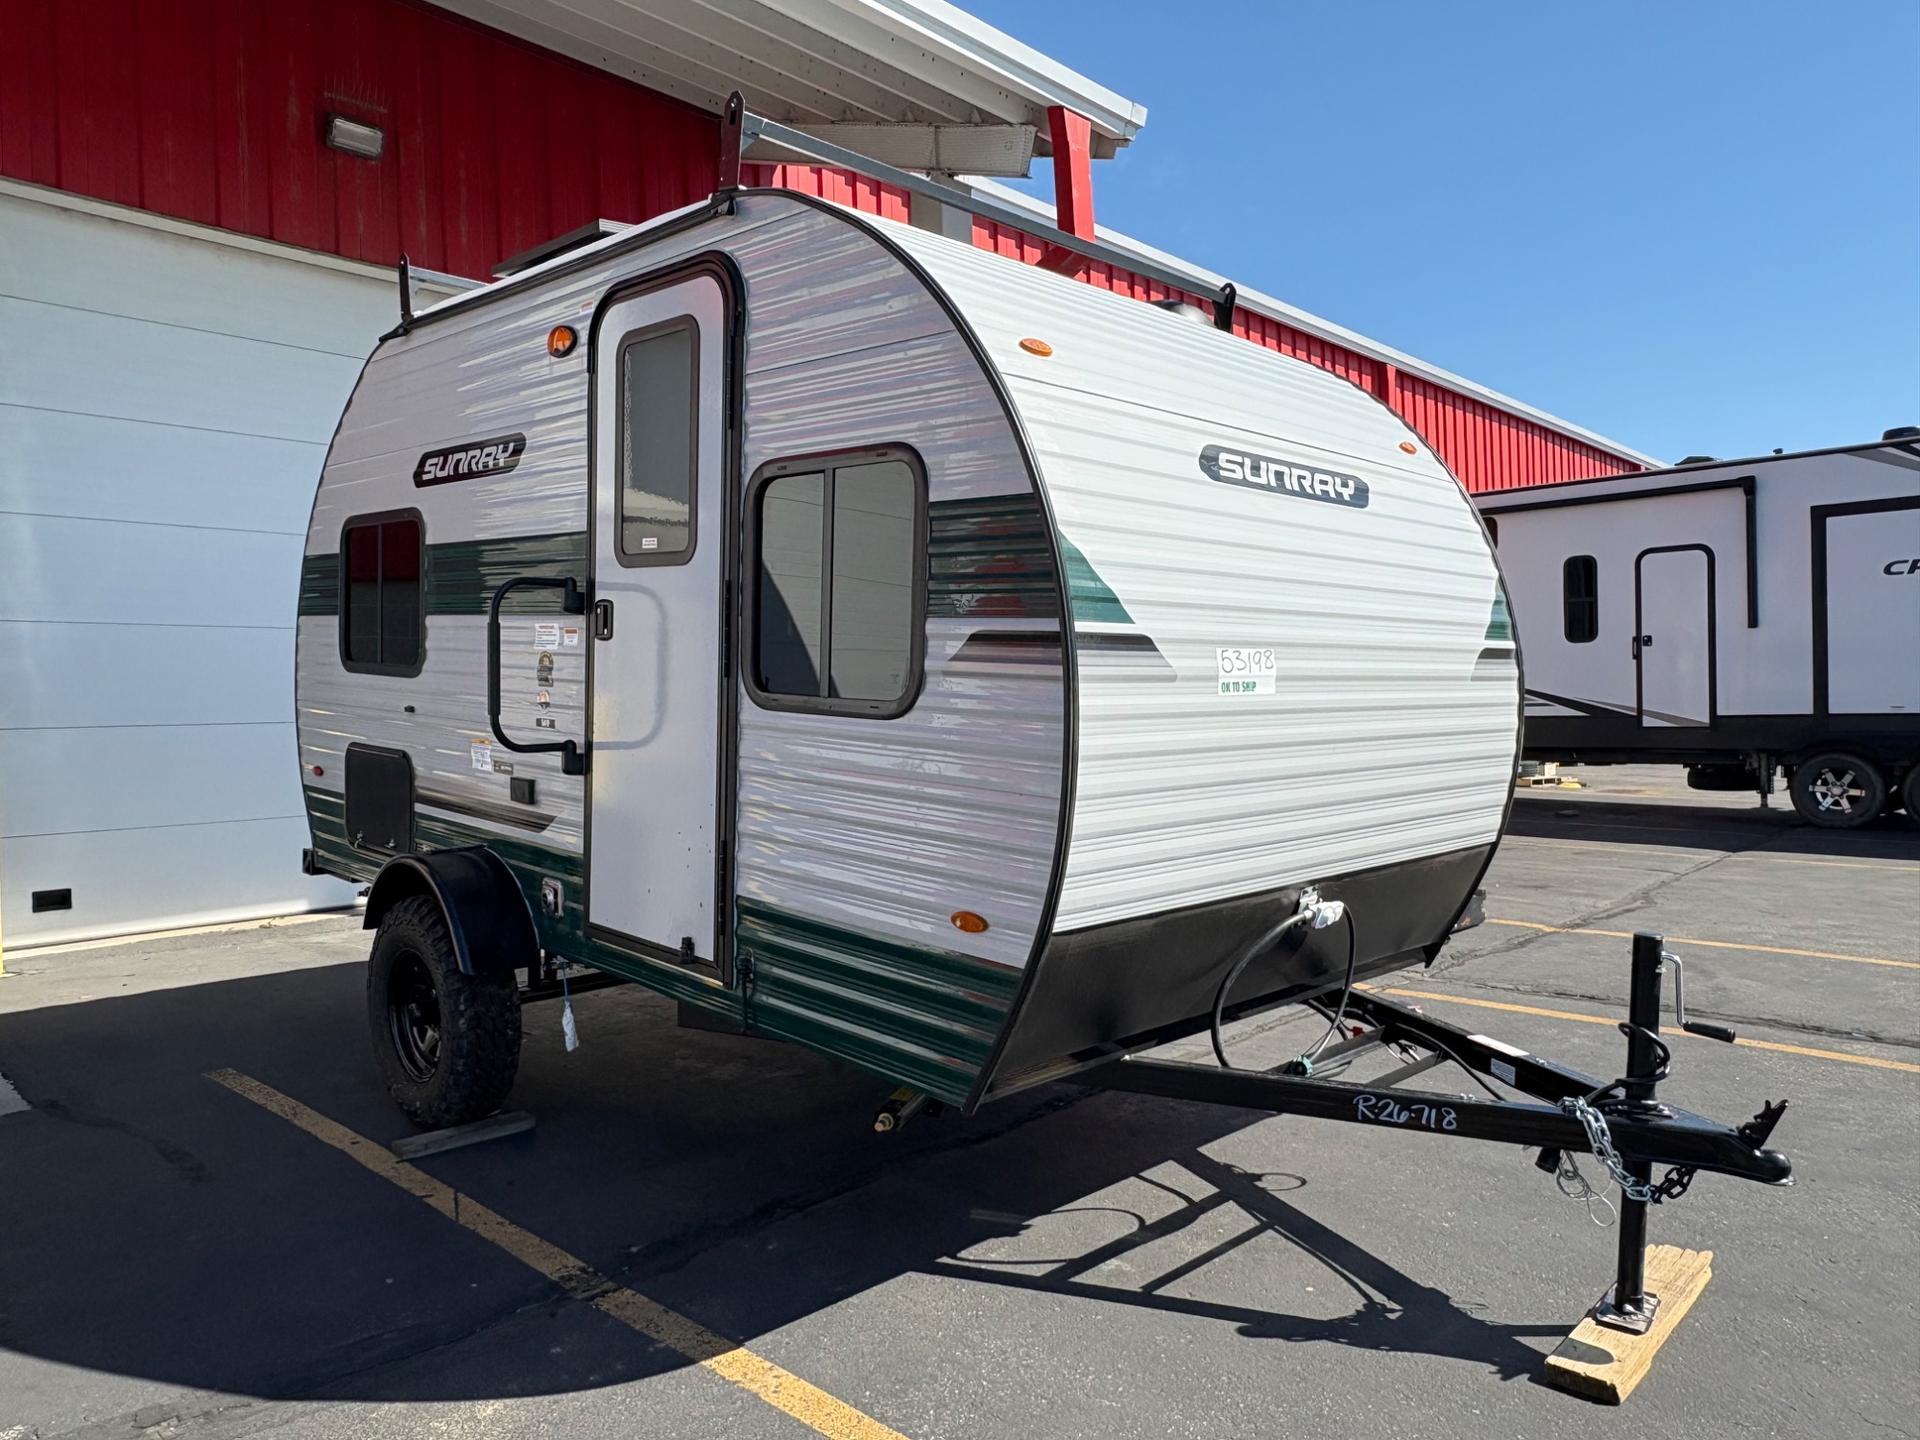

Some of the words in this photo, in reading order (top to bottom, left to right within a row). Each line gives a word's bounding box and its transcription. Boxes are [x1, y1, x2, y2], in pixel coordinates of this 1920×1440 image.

[422, 442, 514, 481] SUNRAY
[1218, 452, 1355, 501] SUNRAY
[1221, 649, 1274, 673] 53198
[1221, 681, 1231, 693] OK
[1232, 681, 1240, 693] TO
